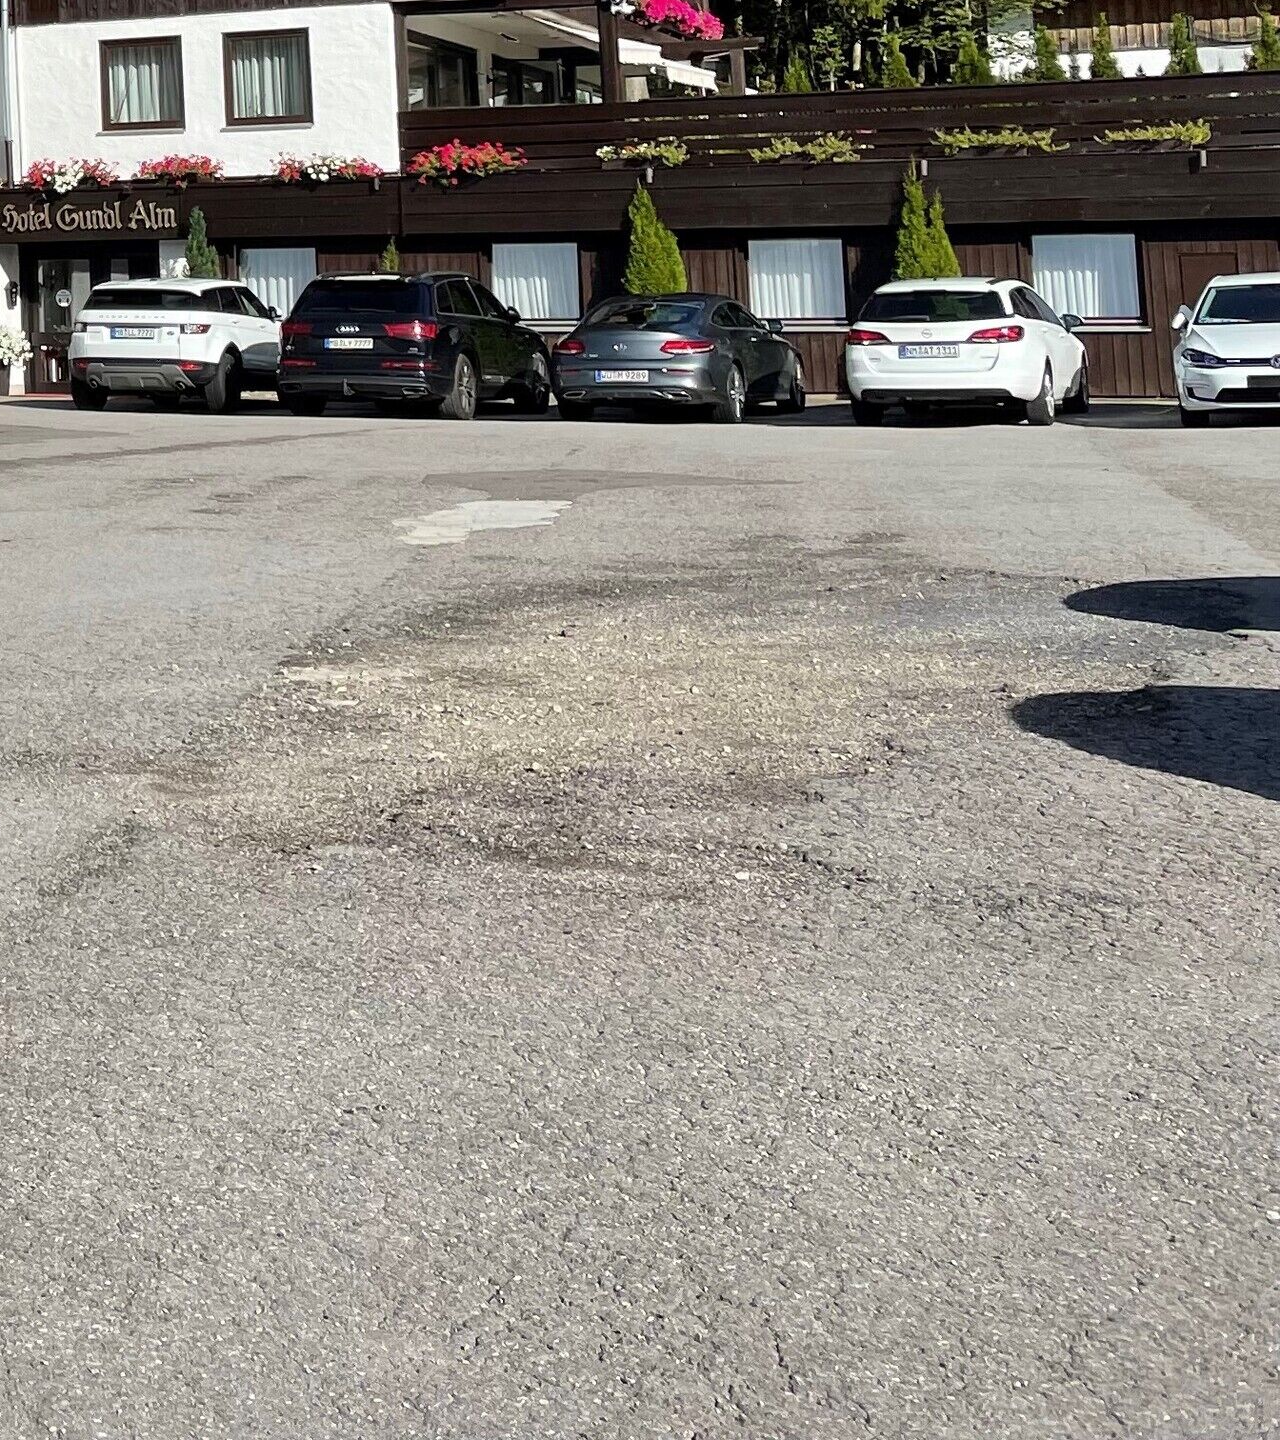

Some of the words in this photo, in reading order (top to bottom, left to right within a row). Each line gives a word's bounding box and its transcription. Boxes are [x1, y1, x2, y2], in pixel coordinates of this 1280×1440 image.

[2, 203, 53, 233] Hotel
[56, 201, 123, 231] Gundl
[128, 199, 178, 230] Alm
